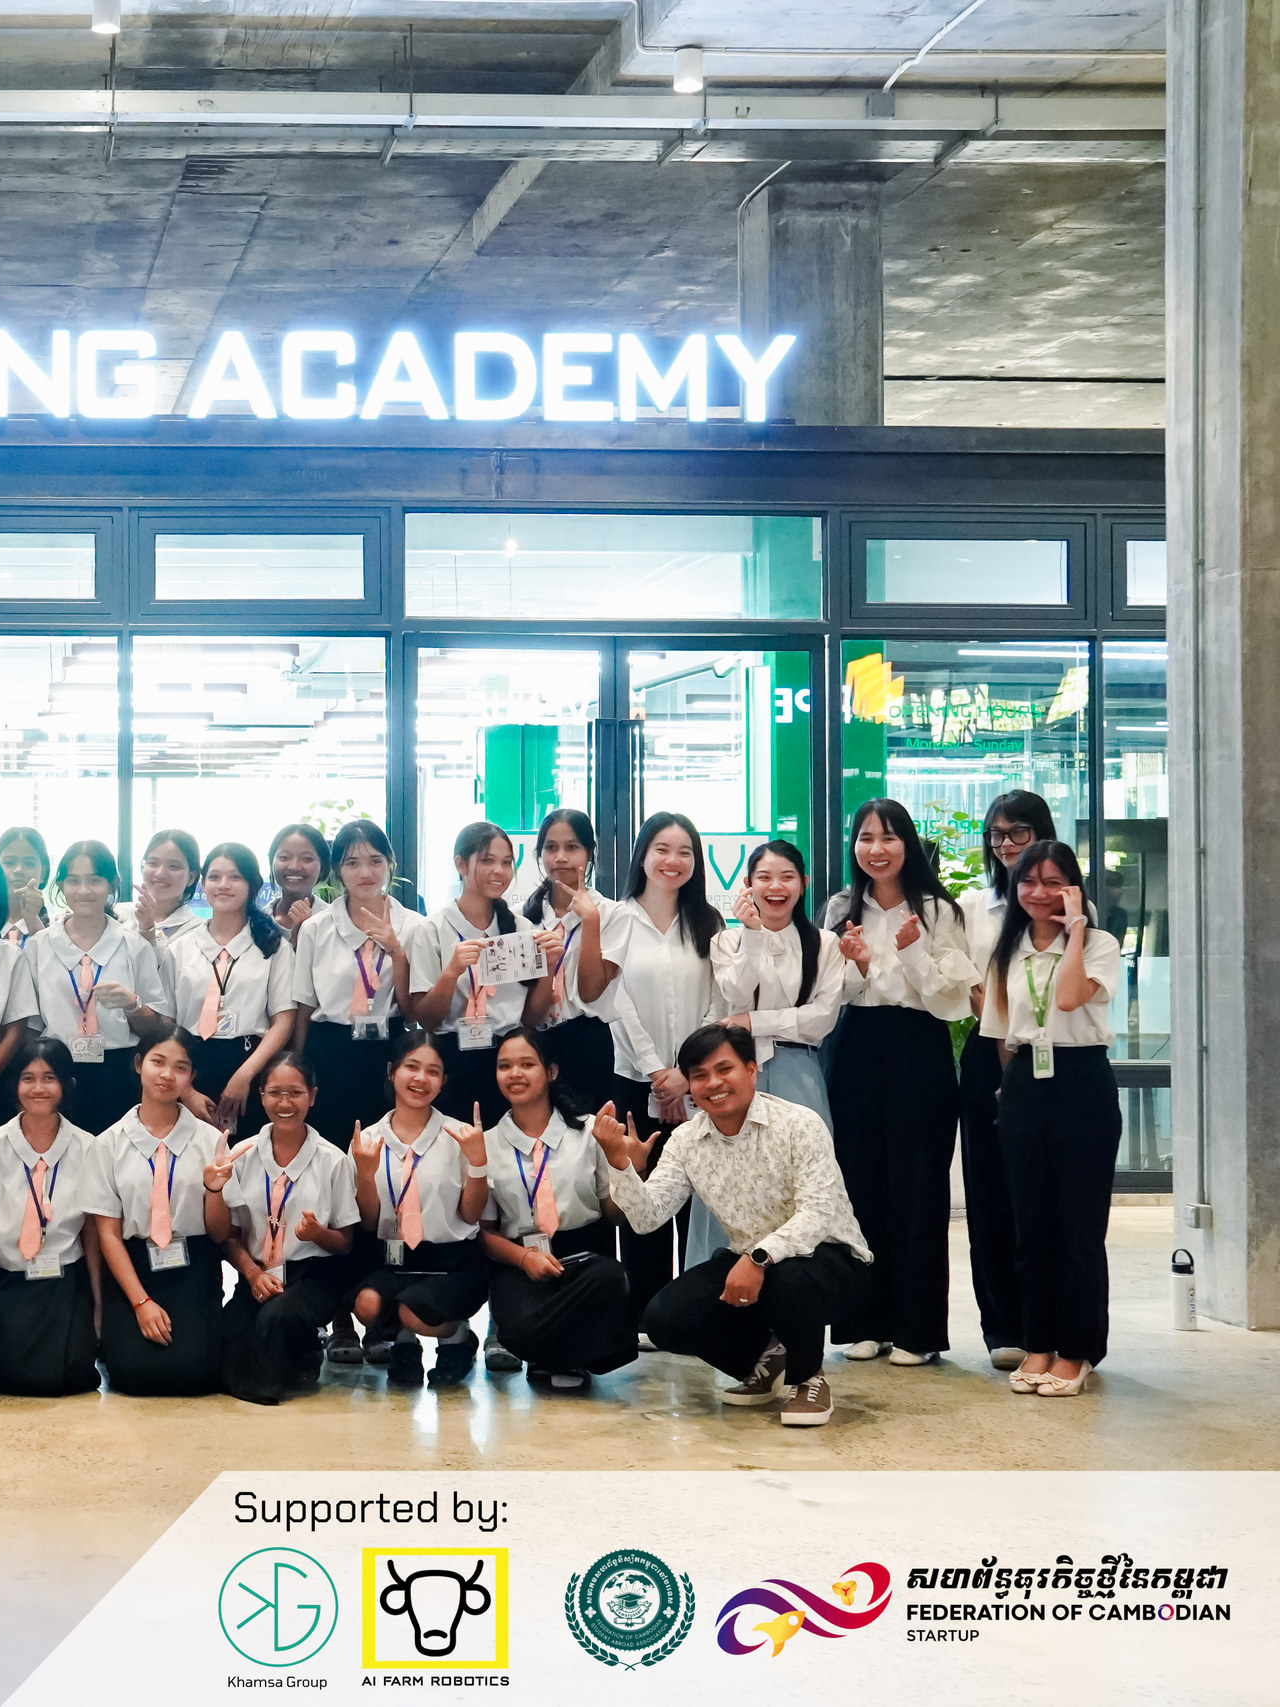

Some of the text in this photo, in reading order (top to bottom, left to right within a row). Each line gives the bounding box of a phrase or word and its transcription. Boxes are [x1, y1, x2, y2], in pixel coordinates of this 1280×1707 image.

[186, 320, 798, 422] ACADEMY
[889, 706, 1042, 718] OPENING HOURS
[906, 739, 959, 751] Monday
[973, 739, 1023, 751] Sunday
